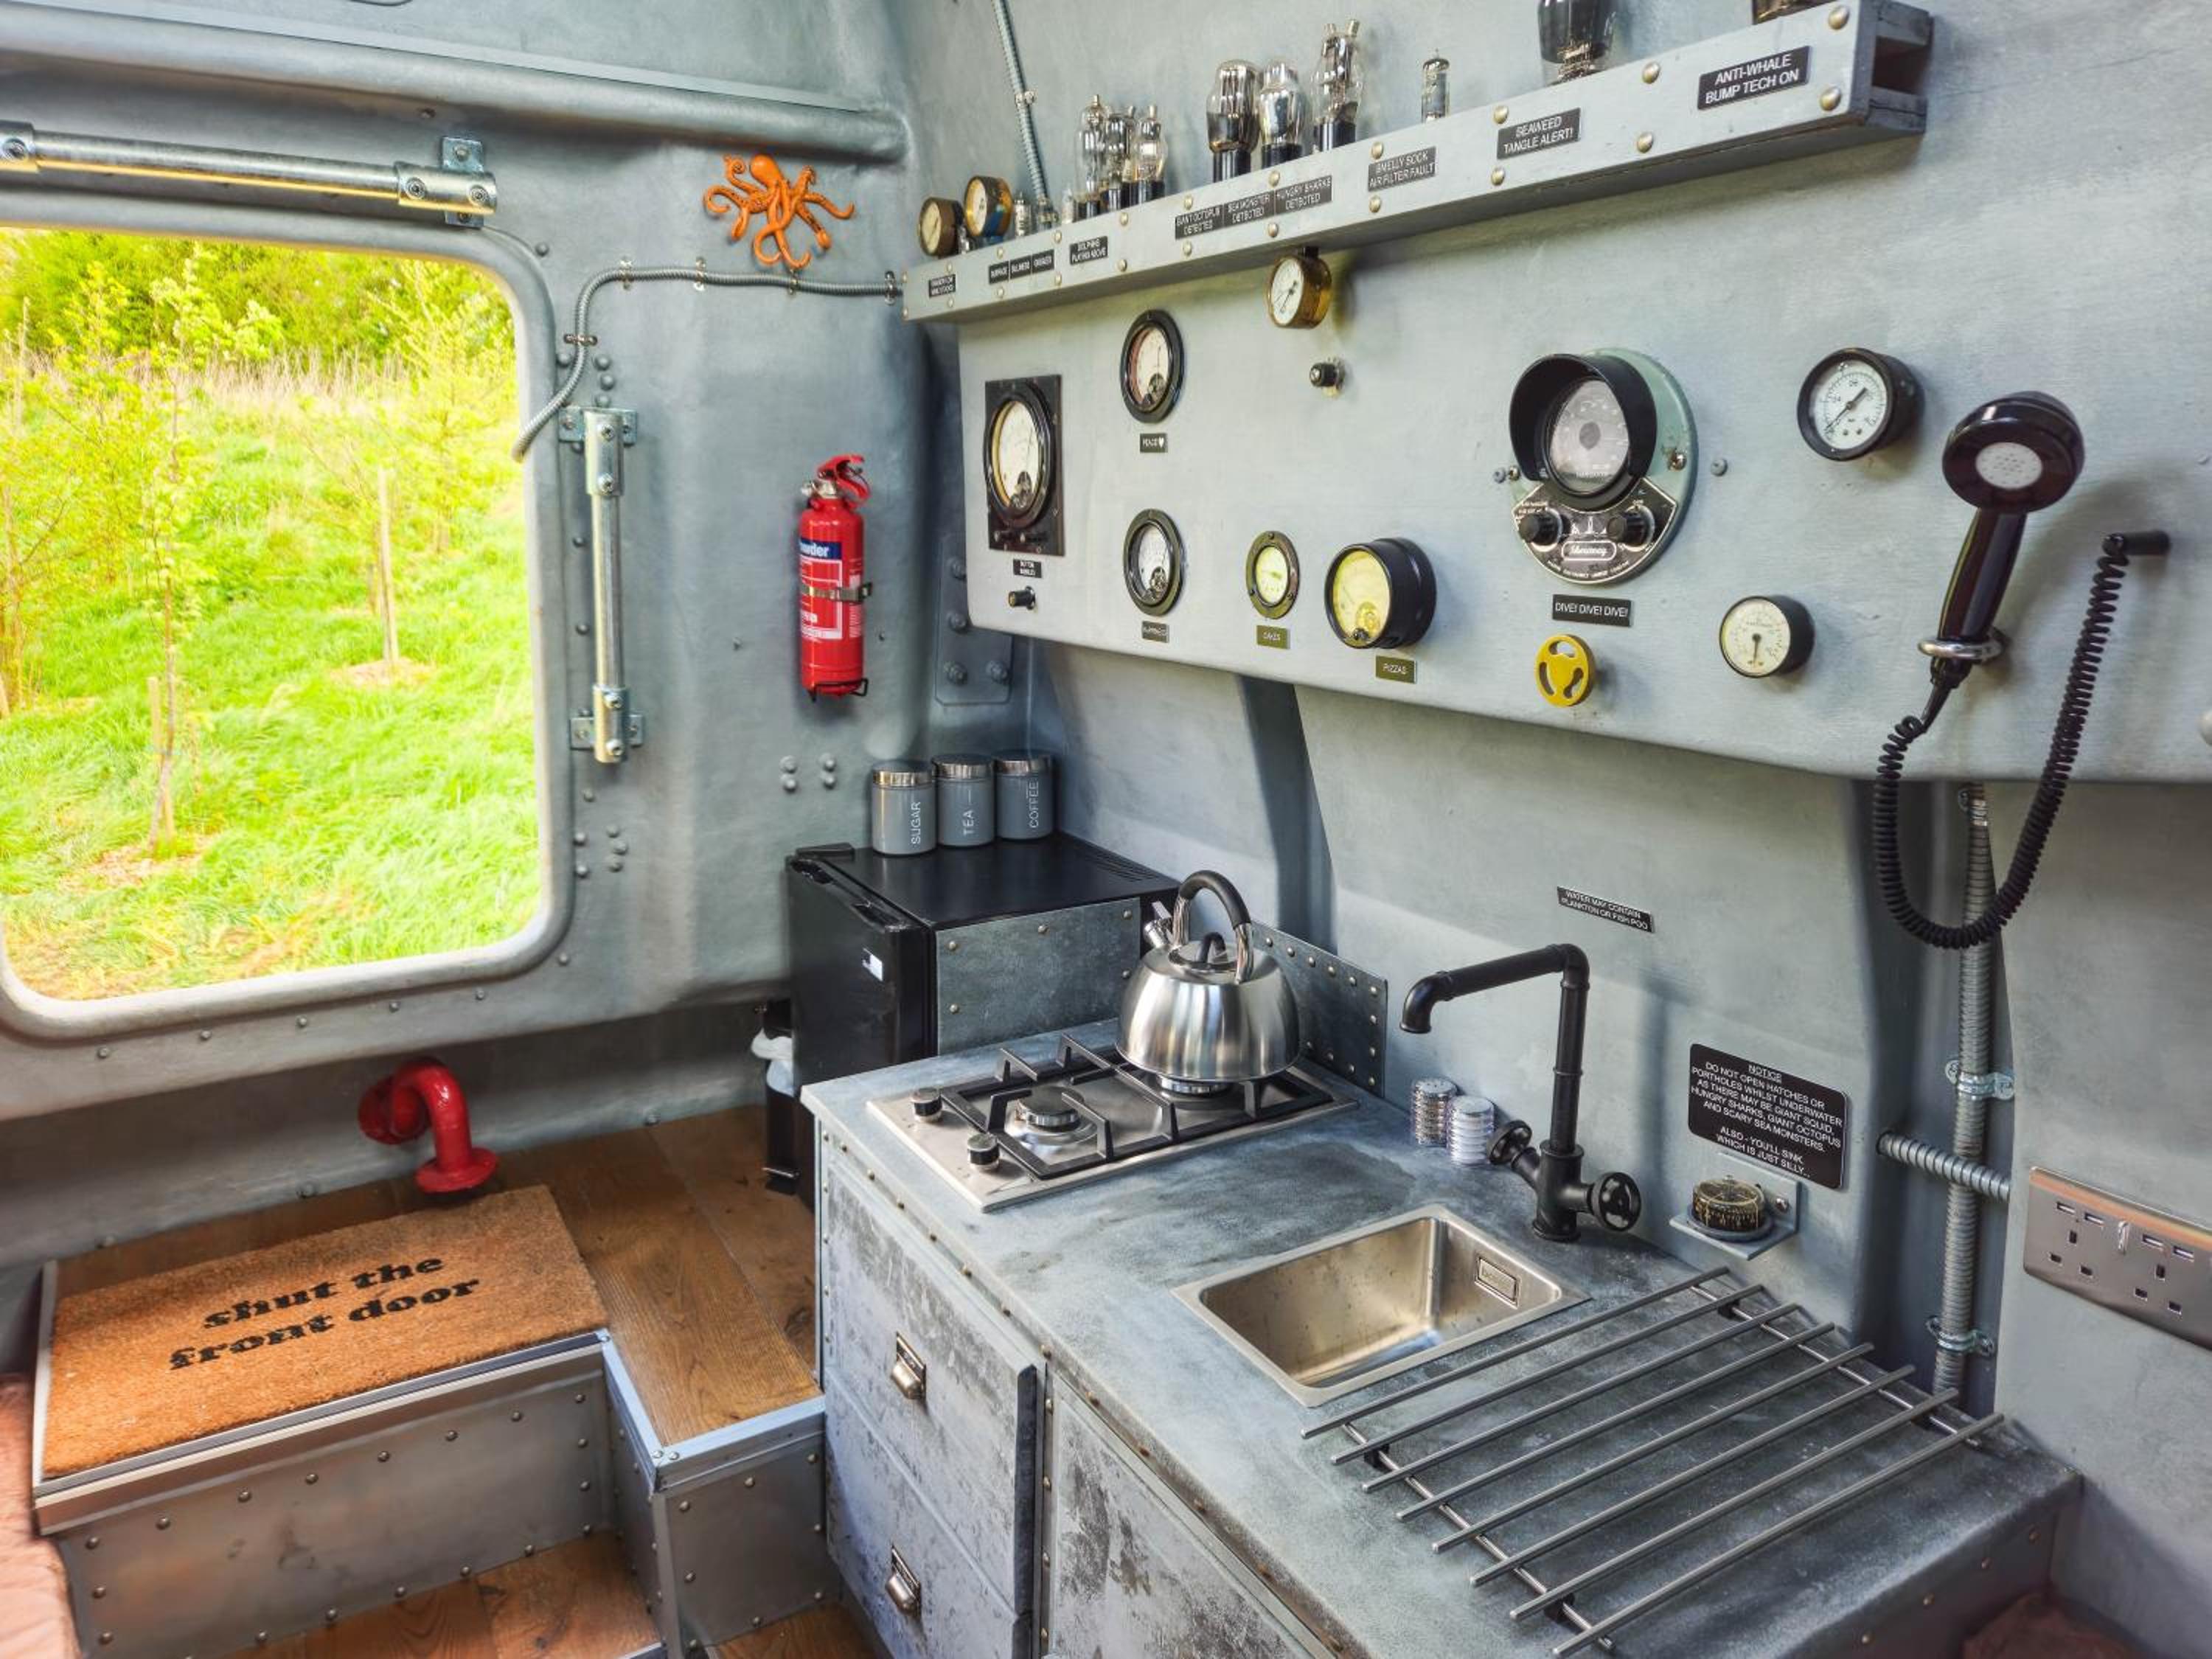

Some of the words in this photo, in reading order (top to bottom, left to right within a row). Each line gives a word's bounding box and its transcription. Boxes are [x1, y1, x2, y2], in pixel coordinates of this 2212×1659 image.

[1714, 53, 1792, 86] ANTI-WHALE
[1705, 85, 1741, 105] BUMP
[1742, 74, 1776, 94] TECH
[1779, 69, 1800, 84] ON
[1503, 136, 1539, 154] TANGLE
[1539, 127, 1573, 147] ALERT!
[1515, 116, 1562, 138] SEAWEED
[1369, 176, 1382, 188] AIR
[1382, 170, 1409, 185] FILTER
[1409, 162, 1435, 177] FAULT
[1376, 157, 1405, 174] SMELLY
[1406, 150, 1429, 165] SOCK
[1285, 193, 1321, 210] DETECTED
[1556, 602, 1578, 613] DIVE!
[1579, 605, 1603, 615] DIVE!
[1604, 606, 1629, 617] DIVE!
[1029, 780, 1039, 828] COFFEE
[911, 801, 921, 844] SUGAR
[963, 809, 974, 835] TEA
[1561, 897, 1599, 916] PLANKTON
[1599, 908, 1611, 919] OR
[1630, 918, 1648, 930] POO
[1565, 890, 1590, 903] WATER
[1591, 897, 1607, 908] MAY
[1608, 903, 1641, 919] CONTAIN
[1705, 1062, 1719, 1073] DO
[1721, 1066, 1739, 1079] NOT
[1740, 1074, 1764, 1089] OPEN
[1767, 1083, 1809, 1104] HATCHES
[1810, 1098, 1826, 1110] OR
[1748, 1065, 1782, 1082] NOTICE
[1691, 1066, 1742, 1091] PORTHOLES
[1745, 1085, 1778, 1101] WHILST
[1779, 1097, 1843, 1127] UNDERWATER
[1697, 1079, 1708, 1089] AS
[1711, 1082, 1739, 1100] THERE
[1741, 1093, 1759, 1107] MAY
[1760, 1101, 1773, 1112] BE
[1775, 1105, 1802, 1121] GIANT
[1691, 1085, 1727, 1104] HUNGRY
[1728, 1099, 1765, 1121] SHARKS,
[1767, 1114, 1795, 1130] GIANT
[1796, 1124, 1841, 1148] OCTOPUS
[1703, 1101, 1722, 1113] AND
[1723, 1107, 1752, 1124] SCARY
[1754, 1119, 1772, 1132] SEA
[1773, 1125, 1825, 1152] MONSTERS.
[1716, 1133, 1745, 1152] WHICH
[1747, 1146, 1756, 1155] IS
[1757, 1151, 1779, 1164] JUST
[1720, 1126, 1744, 1141] ALSO
[1750, 1136, 1780, 1155] YOU'LL
[204, 1281, 340, 1329] shut
[350, 1257, 444, 1290] the
[169, 1314, 335, 1371] front
[348, 1279, 480, 1321] door
